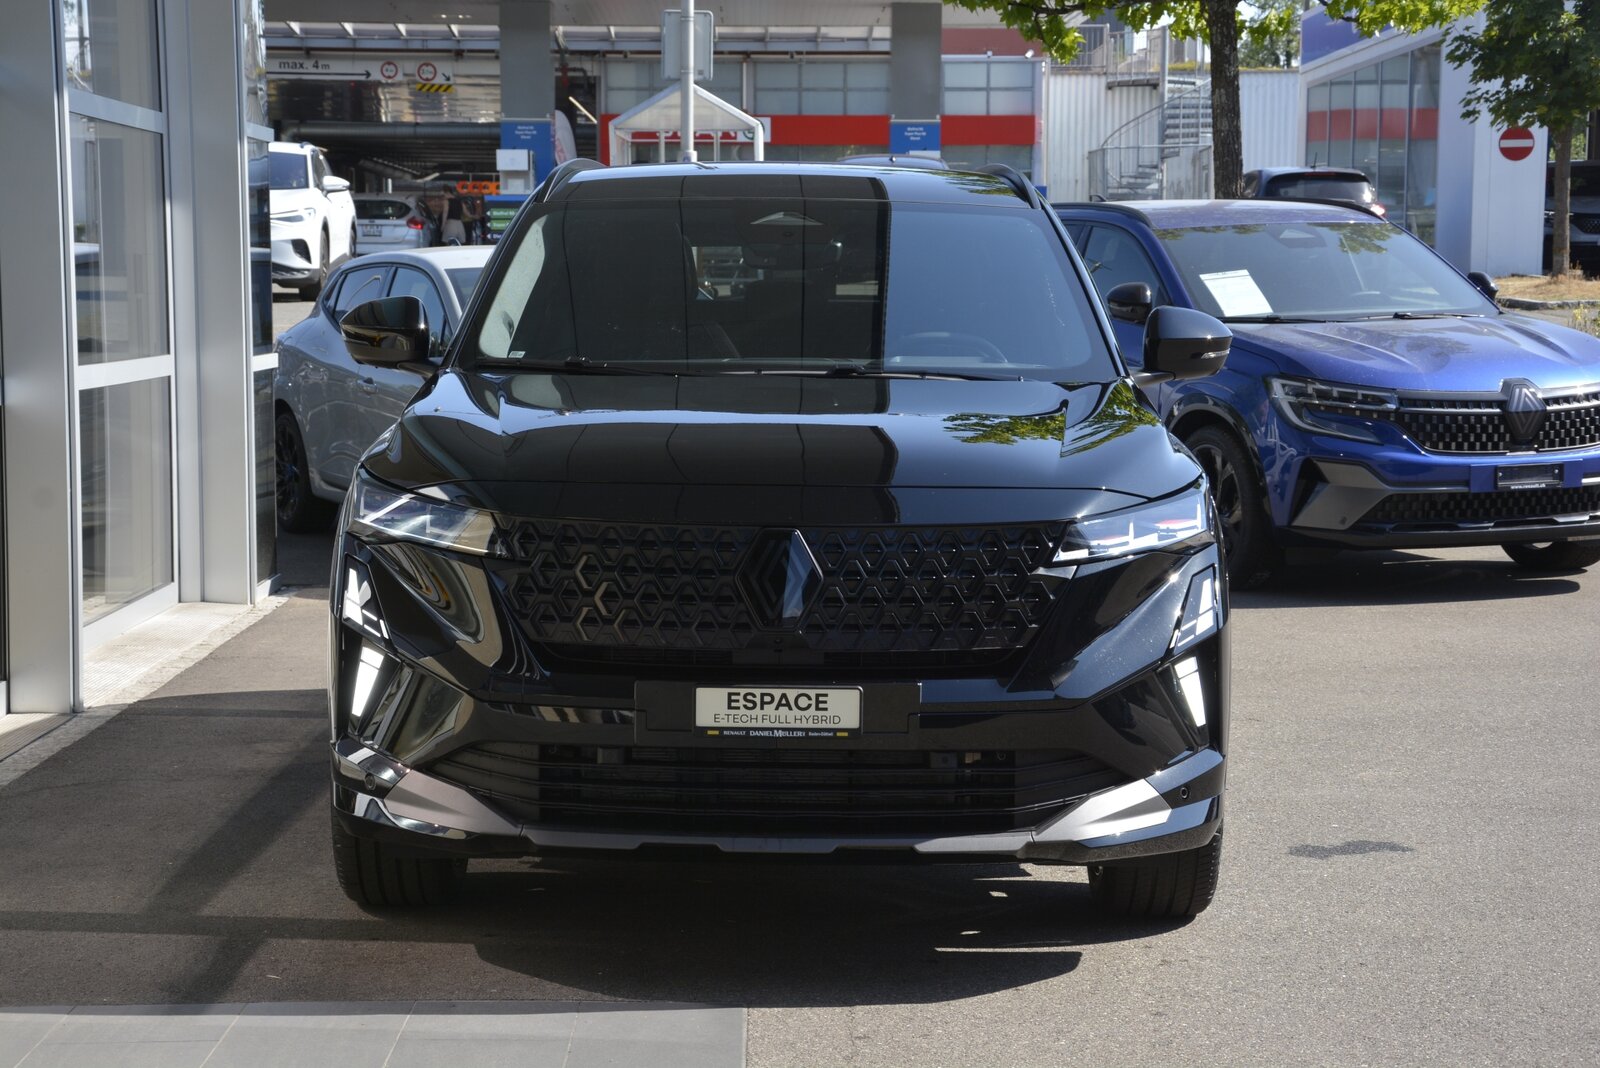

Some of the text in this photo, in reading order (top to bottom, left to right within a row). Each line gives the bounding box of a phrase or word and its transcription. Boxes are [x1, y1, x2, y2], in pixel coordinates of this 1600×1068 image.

[278, 61, 309, 70] max.
[312, 60, 320, 70] 4
[727, 692, 829, 711] ESPACE
[713, 713, 842, 725] E-TECH FULL HYBRID
